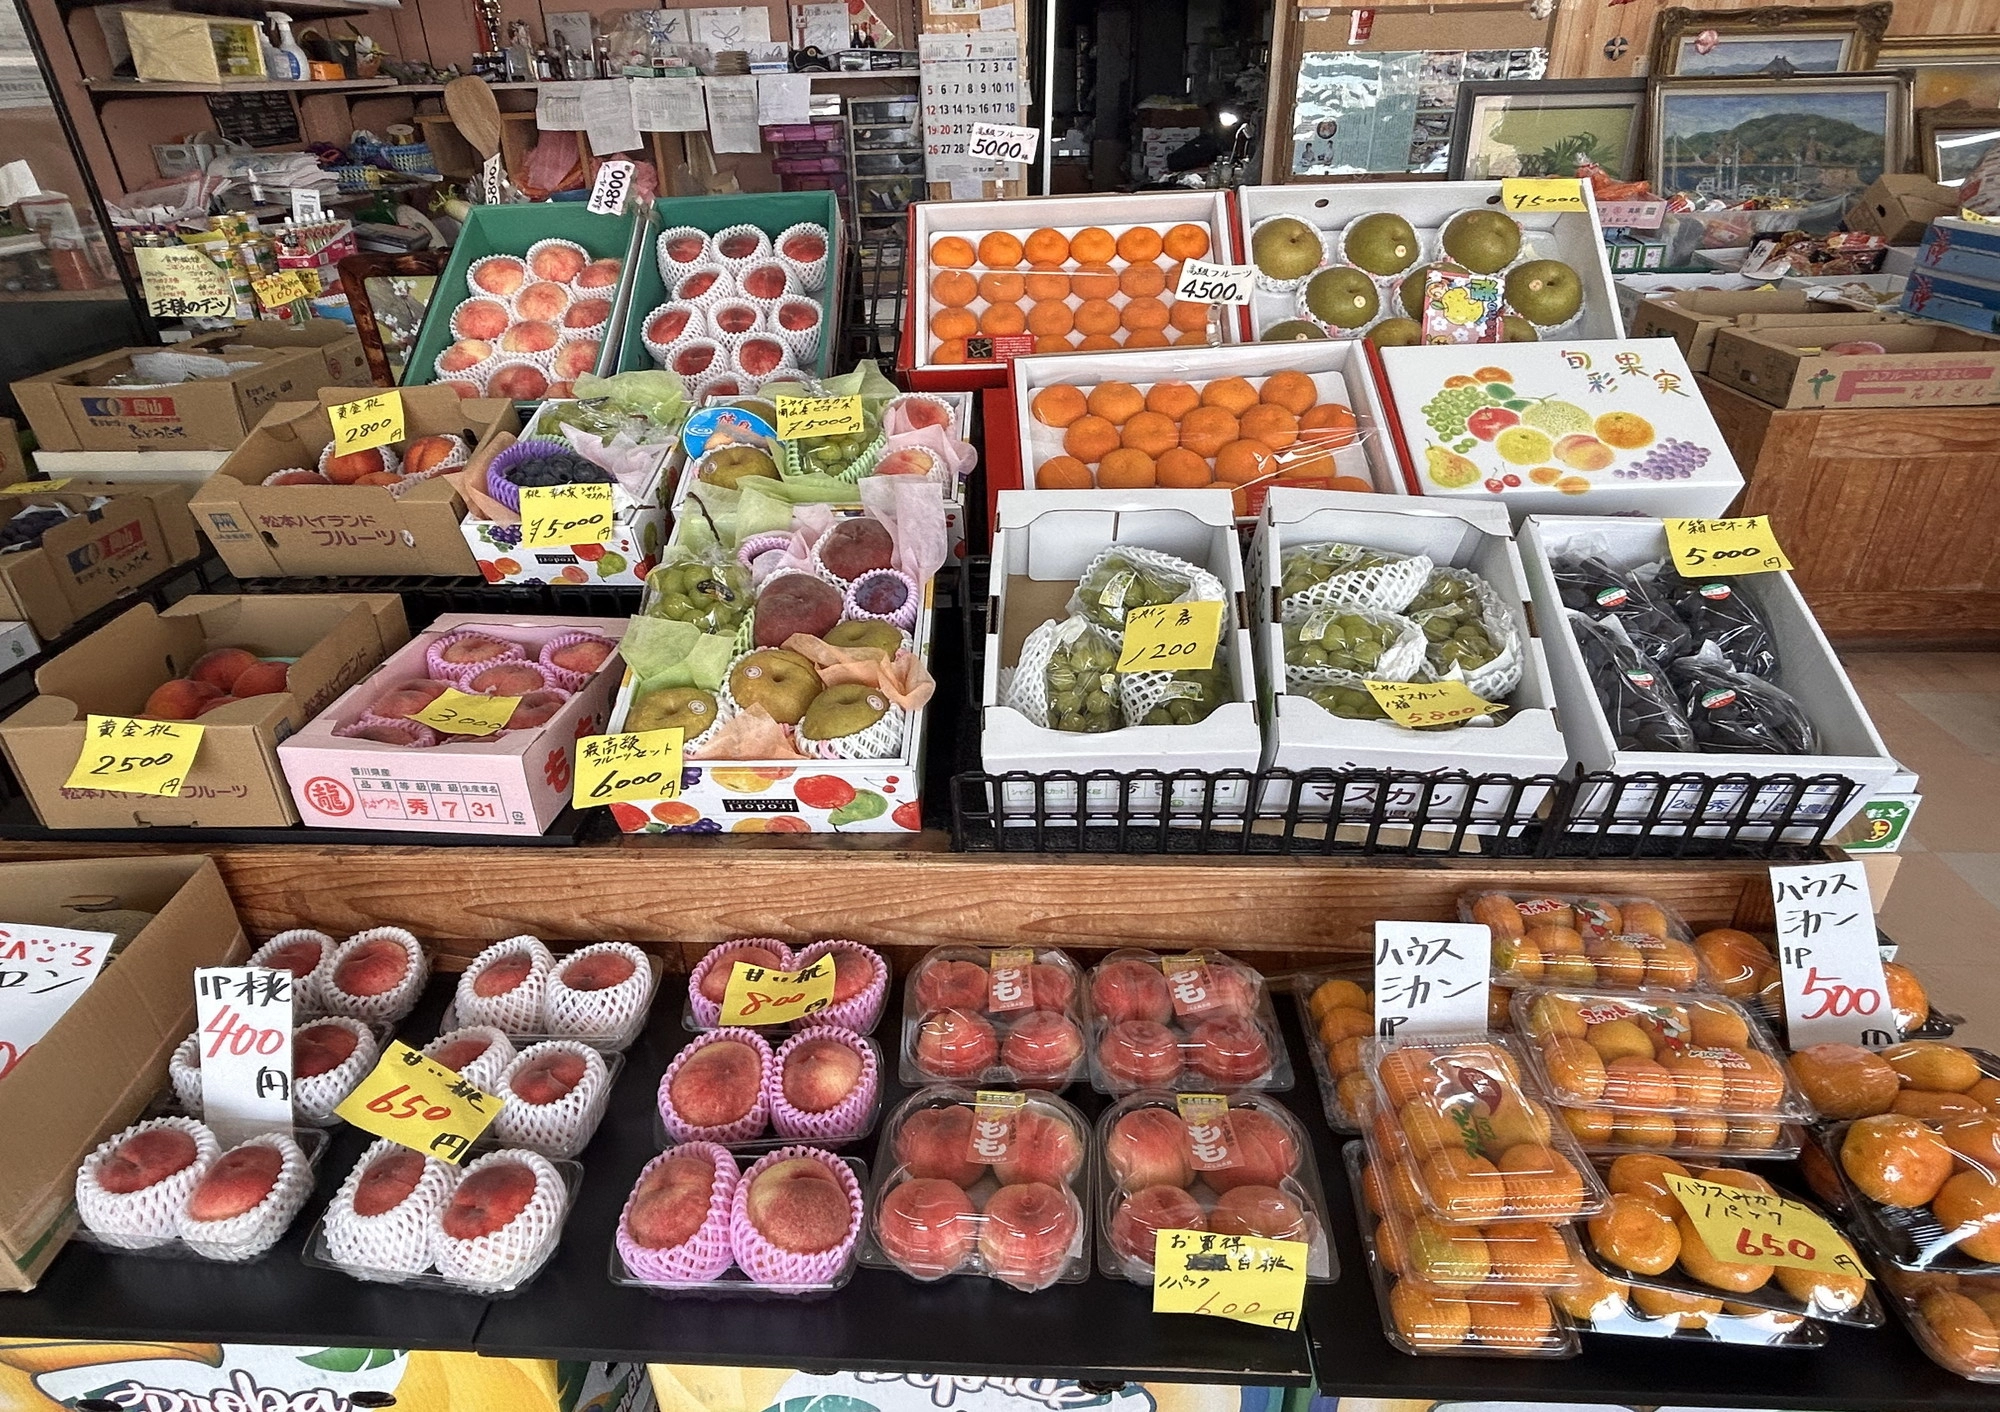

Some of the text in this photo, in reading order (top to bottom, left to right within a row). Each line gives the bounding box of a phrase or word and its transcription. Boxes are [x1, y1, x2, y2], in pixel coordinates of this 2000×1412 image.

[965, 44, 973, 57] 7
[967, 62, 1013, 73] 1 2 3 4
[927, 82, 1014, 95] 5 6 7 8 9 10 11
[927, 102, 1015, 115] 12 13 14 15 16 17 18
[928, 126, 937, 135] 19
[940, 125, 950, 135] 20
[953, 124, 963, 134] 21
[975, 126, 1035, 140] 高級フルーツ
[928, 144, 964, 155] 26 27 28
[972, 138, 1022, 159] 5000
[604, 169, 626, 210] 4800
[1187, 264, 1252, 278] 高級フルーツ
[1181, 279, 1237, 301] 4500
[151, 297, 232, 317] 王様のデーツ
[336, 398, 385, 420] 黄金桃
[345, 418, 402, 443] 2800 円
[259, 514, 376, 528] 松本ハイランド
[311, 530, 396, 546] フルーツ
[597, 526, 611, 541] 円
[1763, 556, 1782, 569] 円
[1129, 607, 1167, 624] シャイン
[1123, 642, 1197, 667] 1200
[1395, 689, 1450, 701] マスカット
[98, 719, 181, 738] 黄金桃
[583, 735, 641, 759] 最高級
[593, 742, 673, 768] フルーツセット
[89, 753, 180, 794] 2500 円
[350, 767, 392, 777] 香川県産
[181, 785, 248, 799] フルーツ
[312, 782, 346, 811] 龍
[399, 782, 428, 792] 等級
[430, 783, 460, 793] 階級
[462, 784, 498, 794] 生産者名
[660, 780, 675, 798] 円
[407, 798, 429, 816] 秀
[441, 801, 459, 819] 7
[471, 802, 496, 818] 31
[729, 803, 794, 811] irodori
[1776, 873, 1858, 903] ハウス
[1782, 910, 1859, 938] ミカン
[0, 930, 95, 968] べごろ
[1377, 937, 1464, 966] ハウス
[0, 963, 85, 995] ロン
[993, 969, 1022, 1002] もも
[1170, 970, 1206, 1004] もも
[1382, 975, 1482, 1008] ミカン
[1801, 967, 1881, 1020] 500
[740, 991, 806, 1016] 800
[204, 1005, 285, 1058] 400
[256, 1066, 289, 1101] 円
[366, 1084, 452, 1121] 650
[430, 1132, 470, 1160] 円
[973, 1120, 1009, 1157] もも
[1188, 1125, 1228, 1163] もも
[1677, 1181, 1803, 1211] ハウスみかん
[1171, 1234, 1246, 1254] お買得
[1736, 1227, 1864, 1279] 650 円
[1194, 1291, 1295, 1331] 600 円
